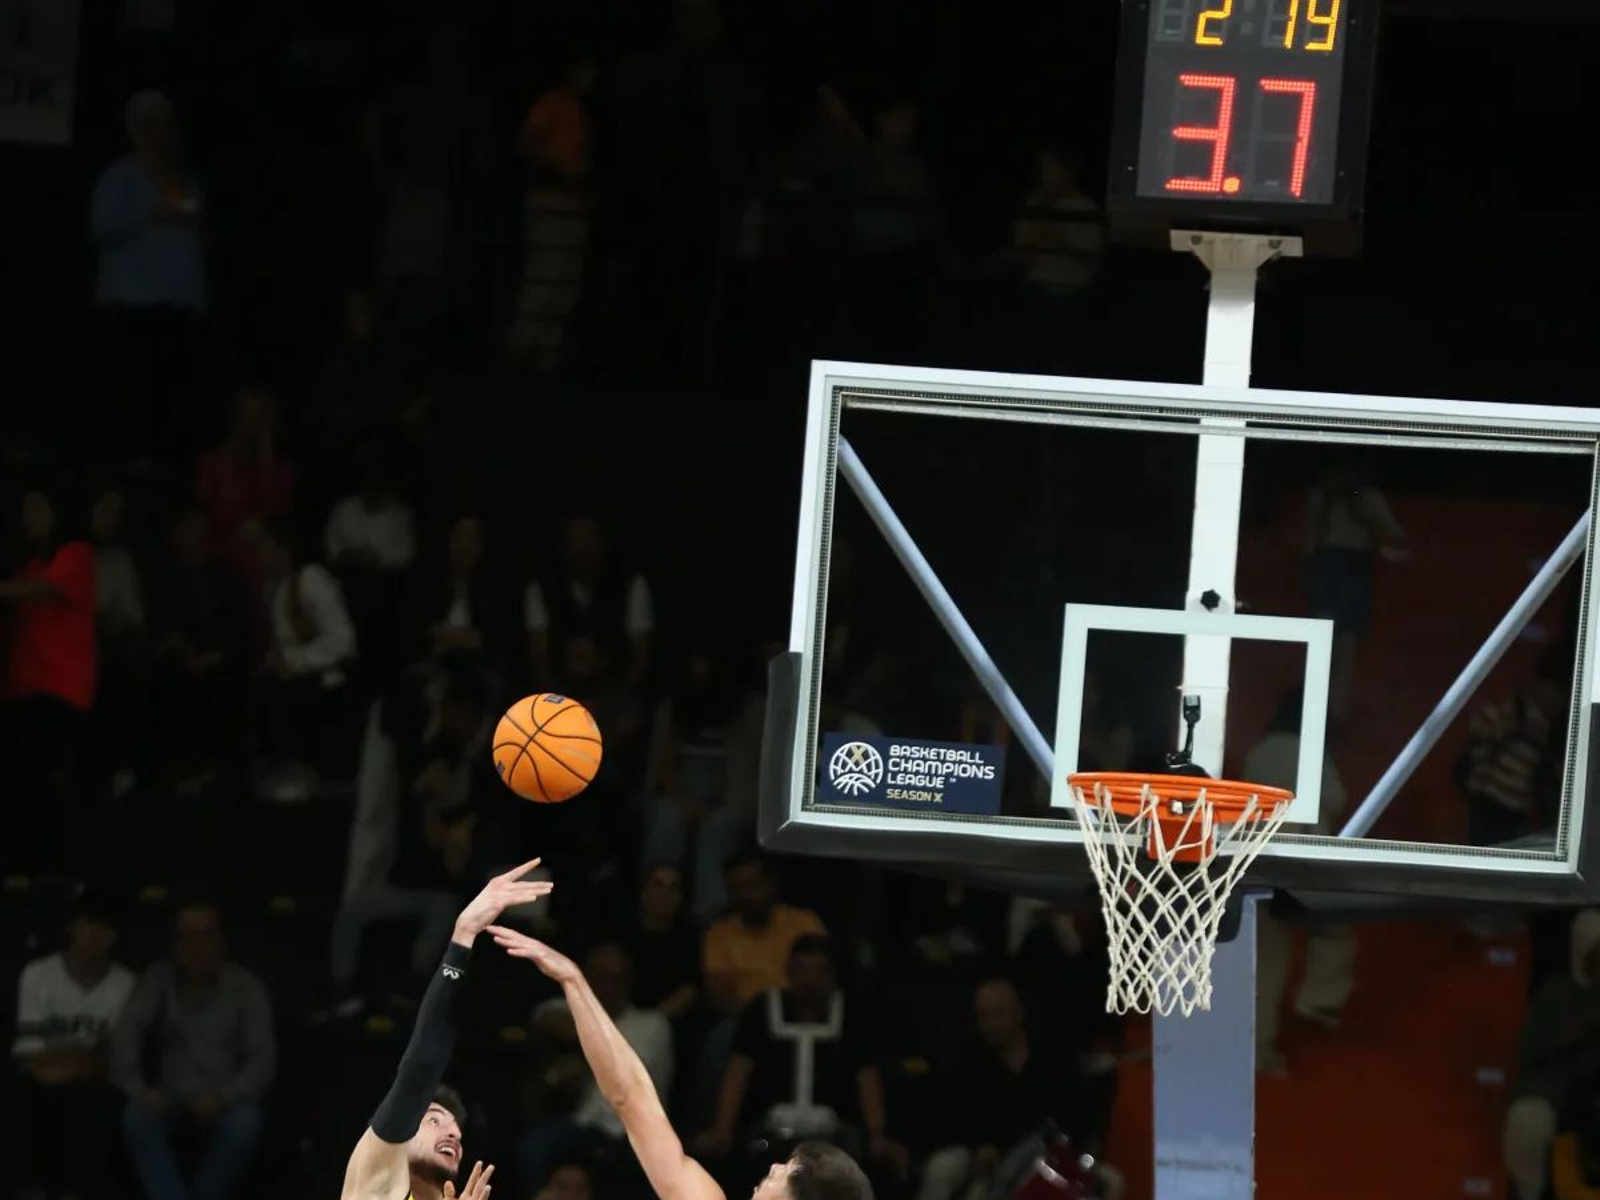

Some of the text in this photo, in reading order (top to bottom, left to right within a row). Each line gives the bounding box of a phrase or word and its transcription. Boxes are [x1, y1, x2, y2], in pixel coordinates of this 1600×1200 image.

[1195, 0, 1232, 45] 2
[889, 744, 985, 764] BASKETBALL
[888, 758, 996, 780] CHAMPIONS
[887, 772, 946, 788] LEAGUE
[886, 788, 944, 803] SEASON X
